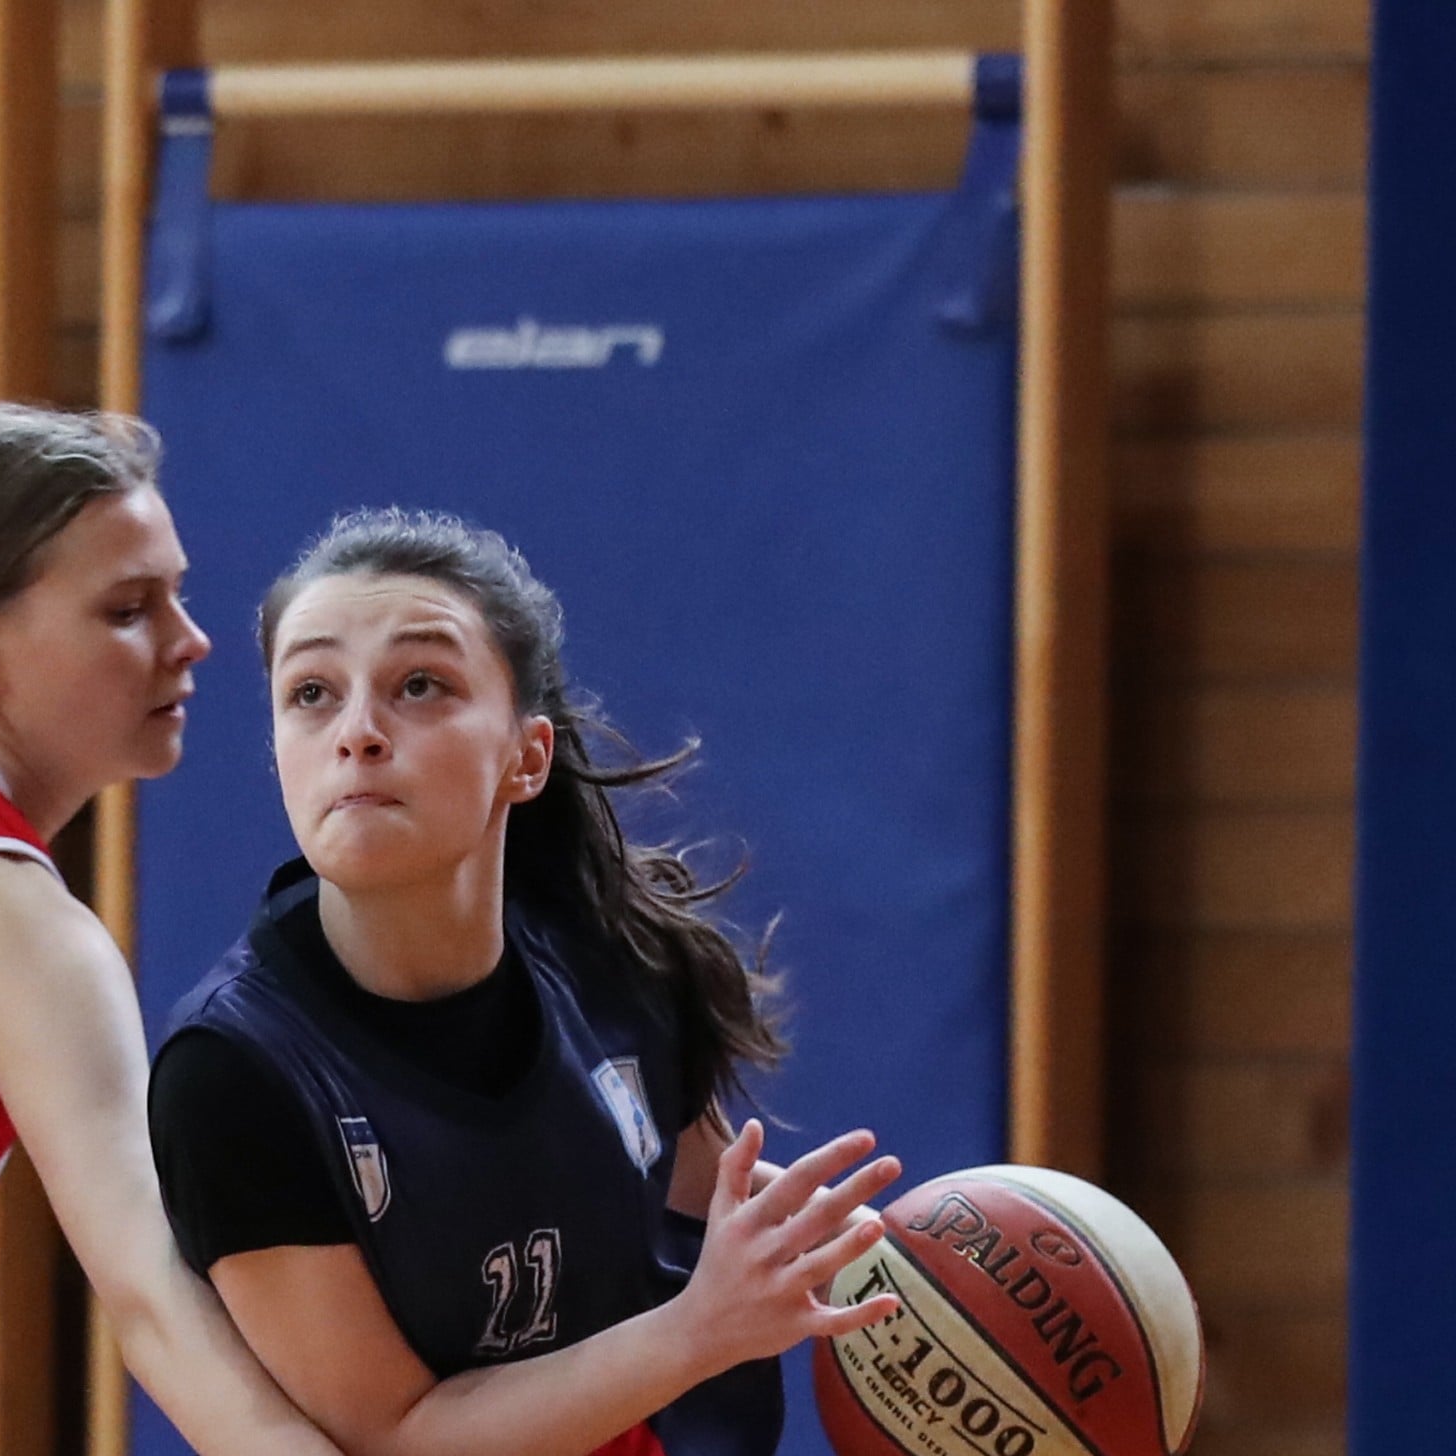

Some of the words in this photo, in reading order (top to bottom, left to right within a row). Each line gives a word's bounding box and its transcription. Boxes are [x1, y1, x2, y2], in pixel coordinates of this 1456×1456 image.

[907, 1191, 1123, 1404] SPALDING
[865, 1375, 914, 1430] CHANNEL
[872, 1353, 944, 1425] LEGACY
